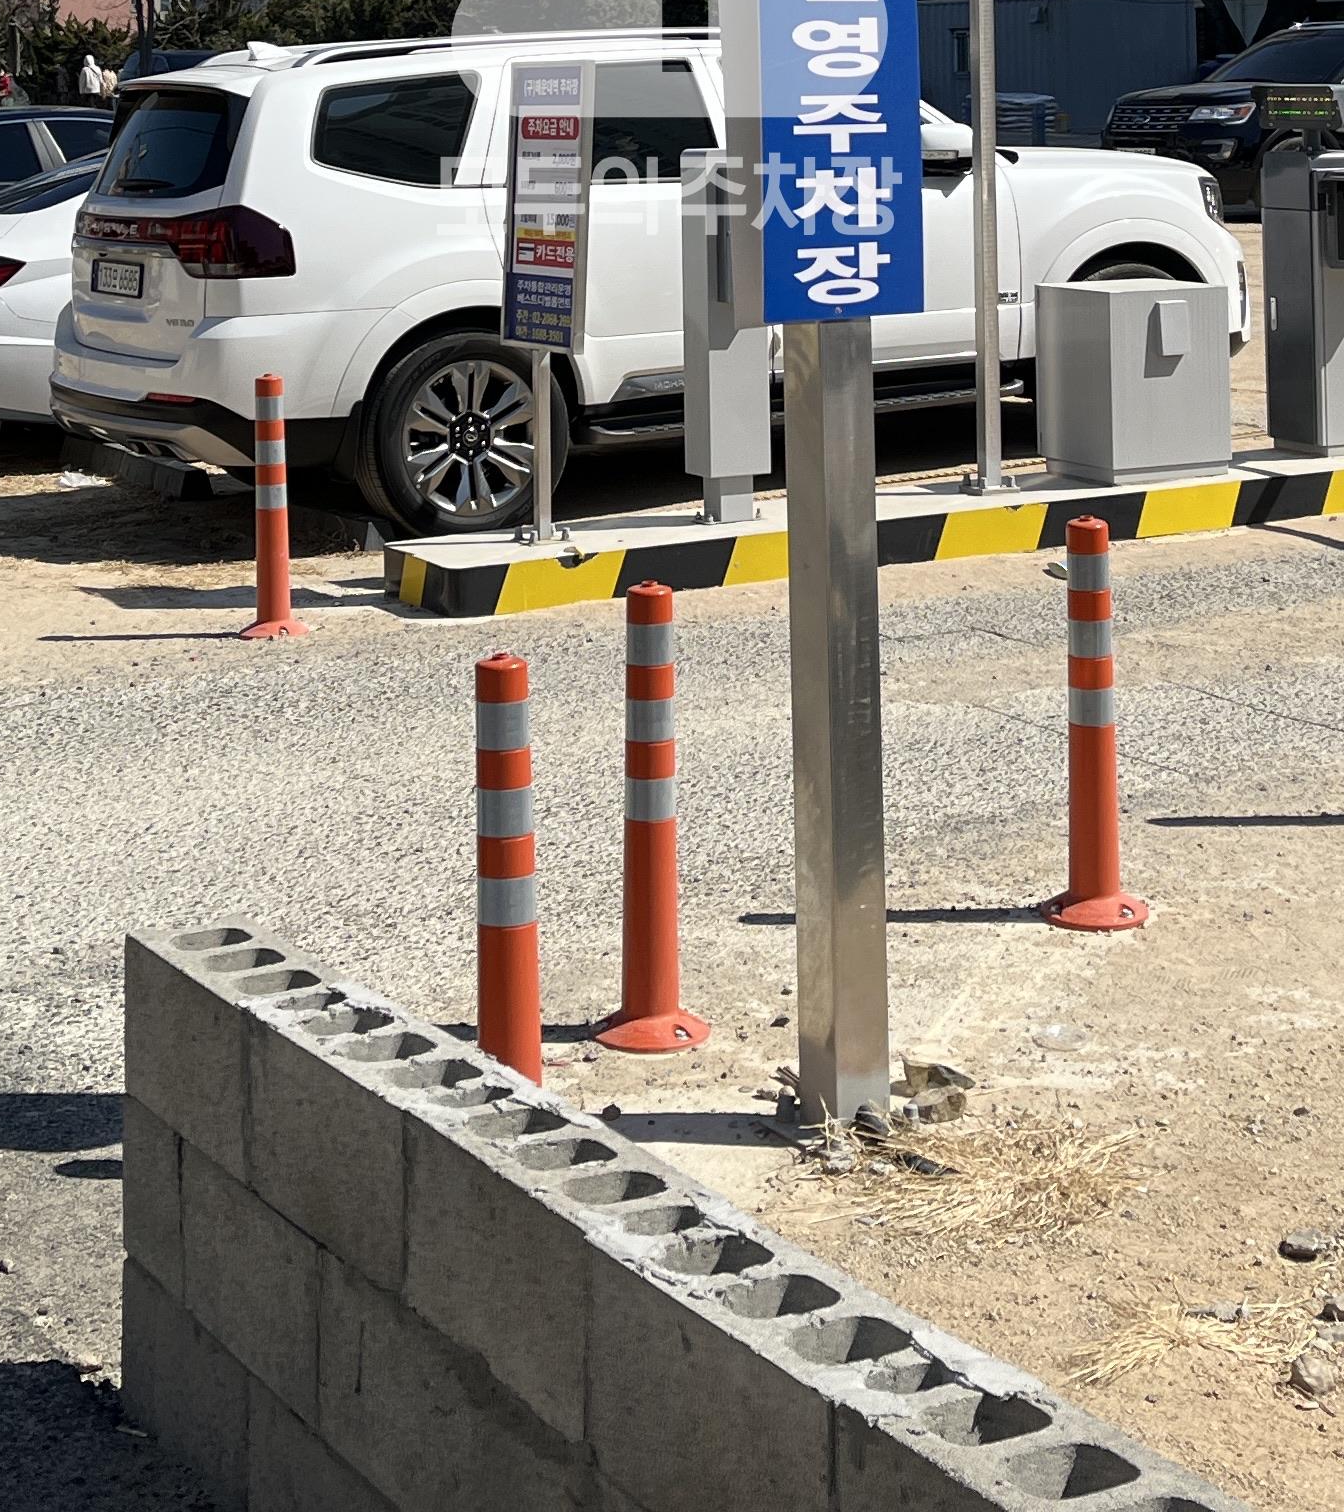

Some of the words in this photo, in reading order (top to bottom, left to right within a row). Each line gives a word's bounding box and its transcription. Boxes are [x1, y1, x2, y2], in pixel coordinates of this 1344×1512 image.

[560, 78, 579, 96] 주차장
[527, 117, 557, 136] 주차요금
[558, 117, 575, 136] 안내
[535, 243, 575, 263] 카드전용
